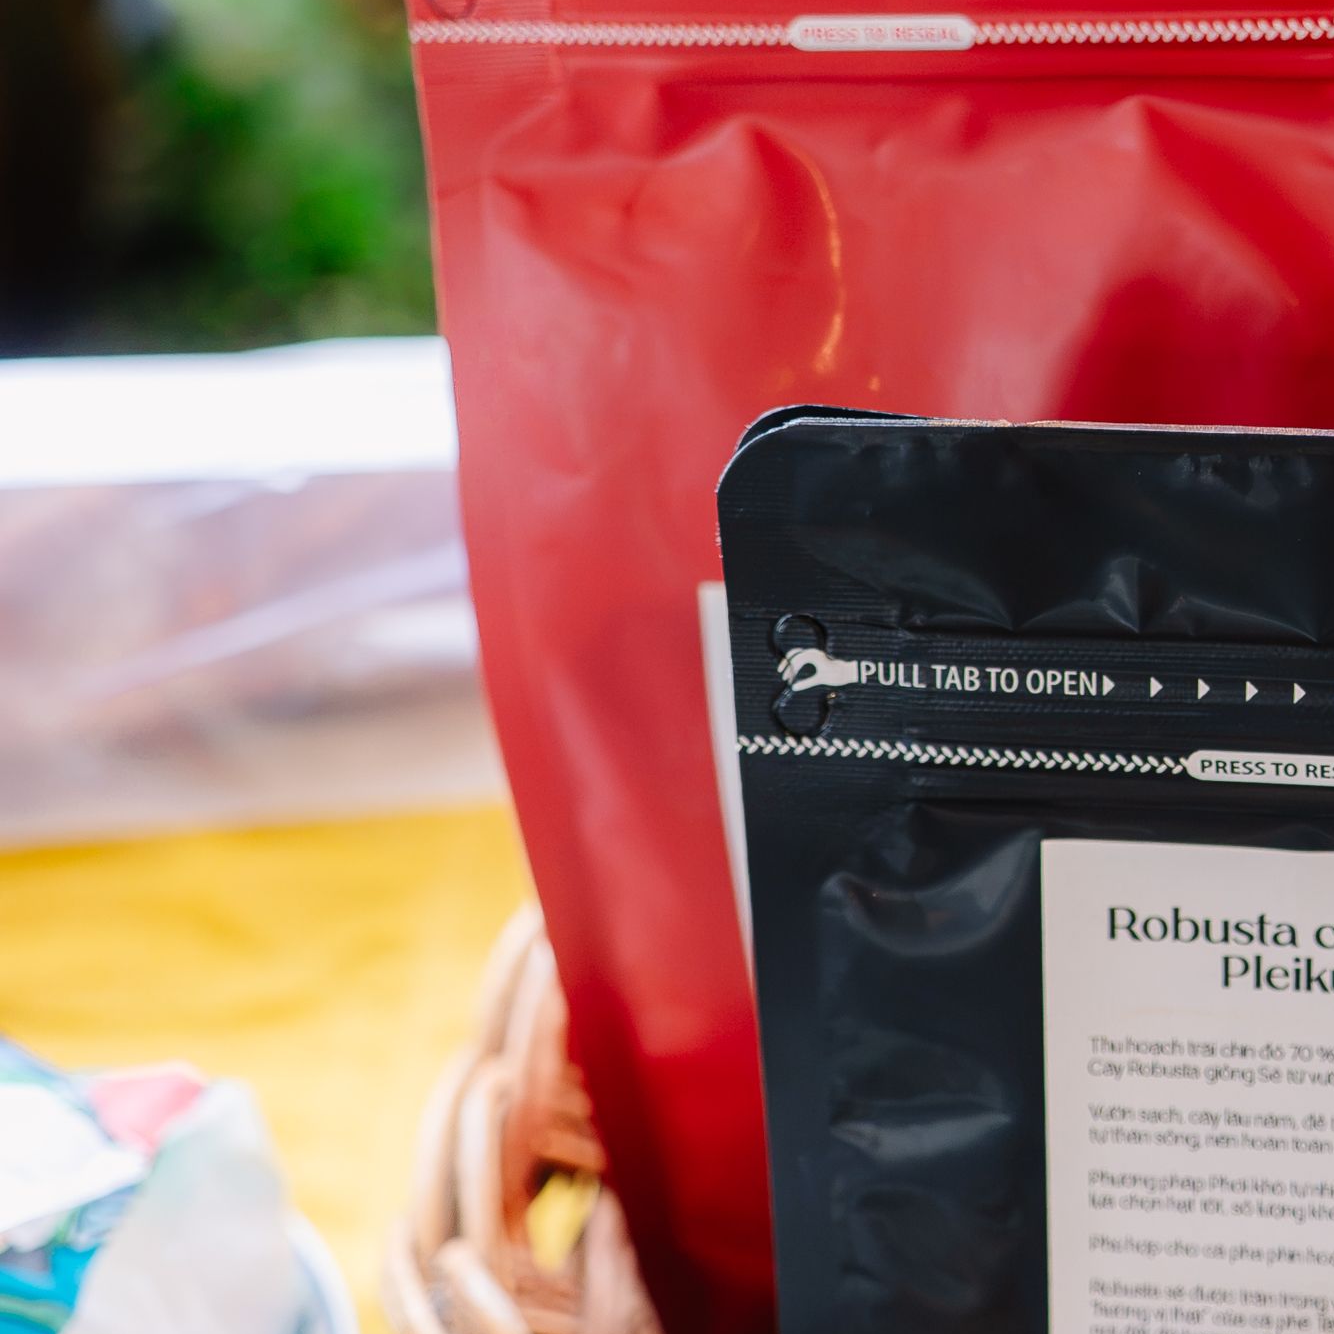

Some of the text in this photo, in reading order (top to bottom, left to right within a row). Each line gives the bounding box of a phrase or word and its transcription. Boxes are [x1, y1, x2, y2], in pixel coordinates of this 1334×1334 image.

[859, 658, 1098, 697] PULL TAB TO OPEN
[1201, 759, 1267, 776] PRESS
[1270, 763, 1298, 777] TO
[1107, 906, 1299, 948] Robusta
